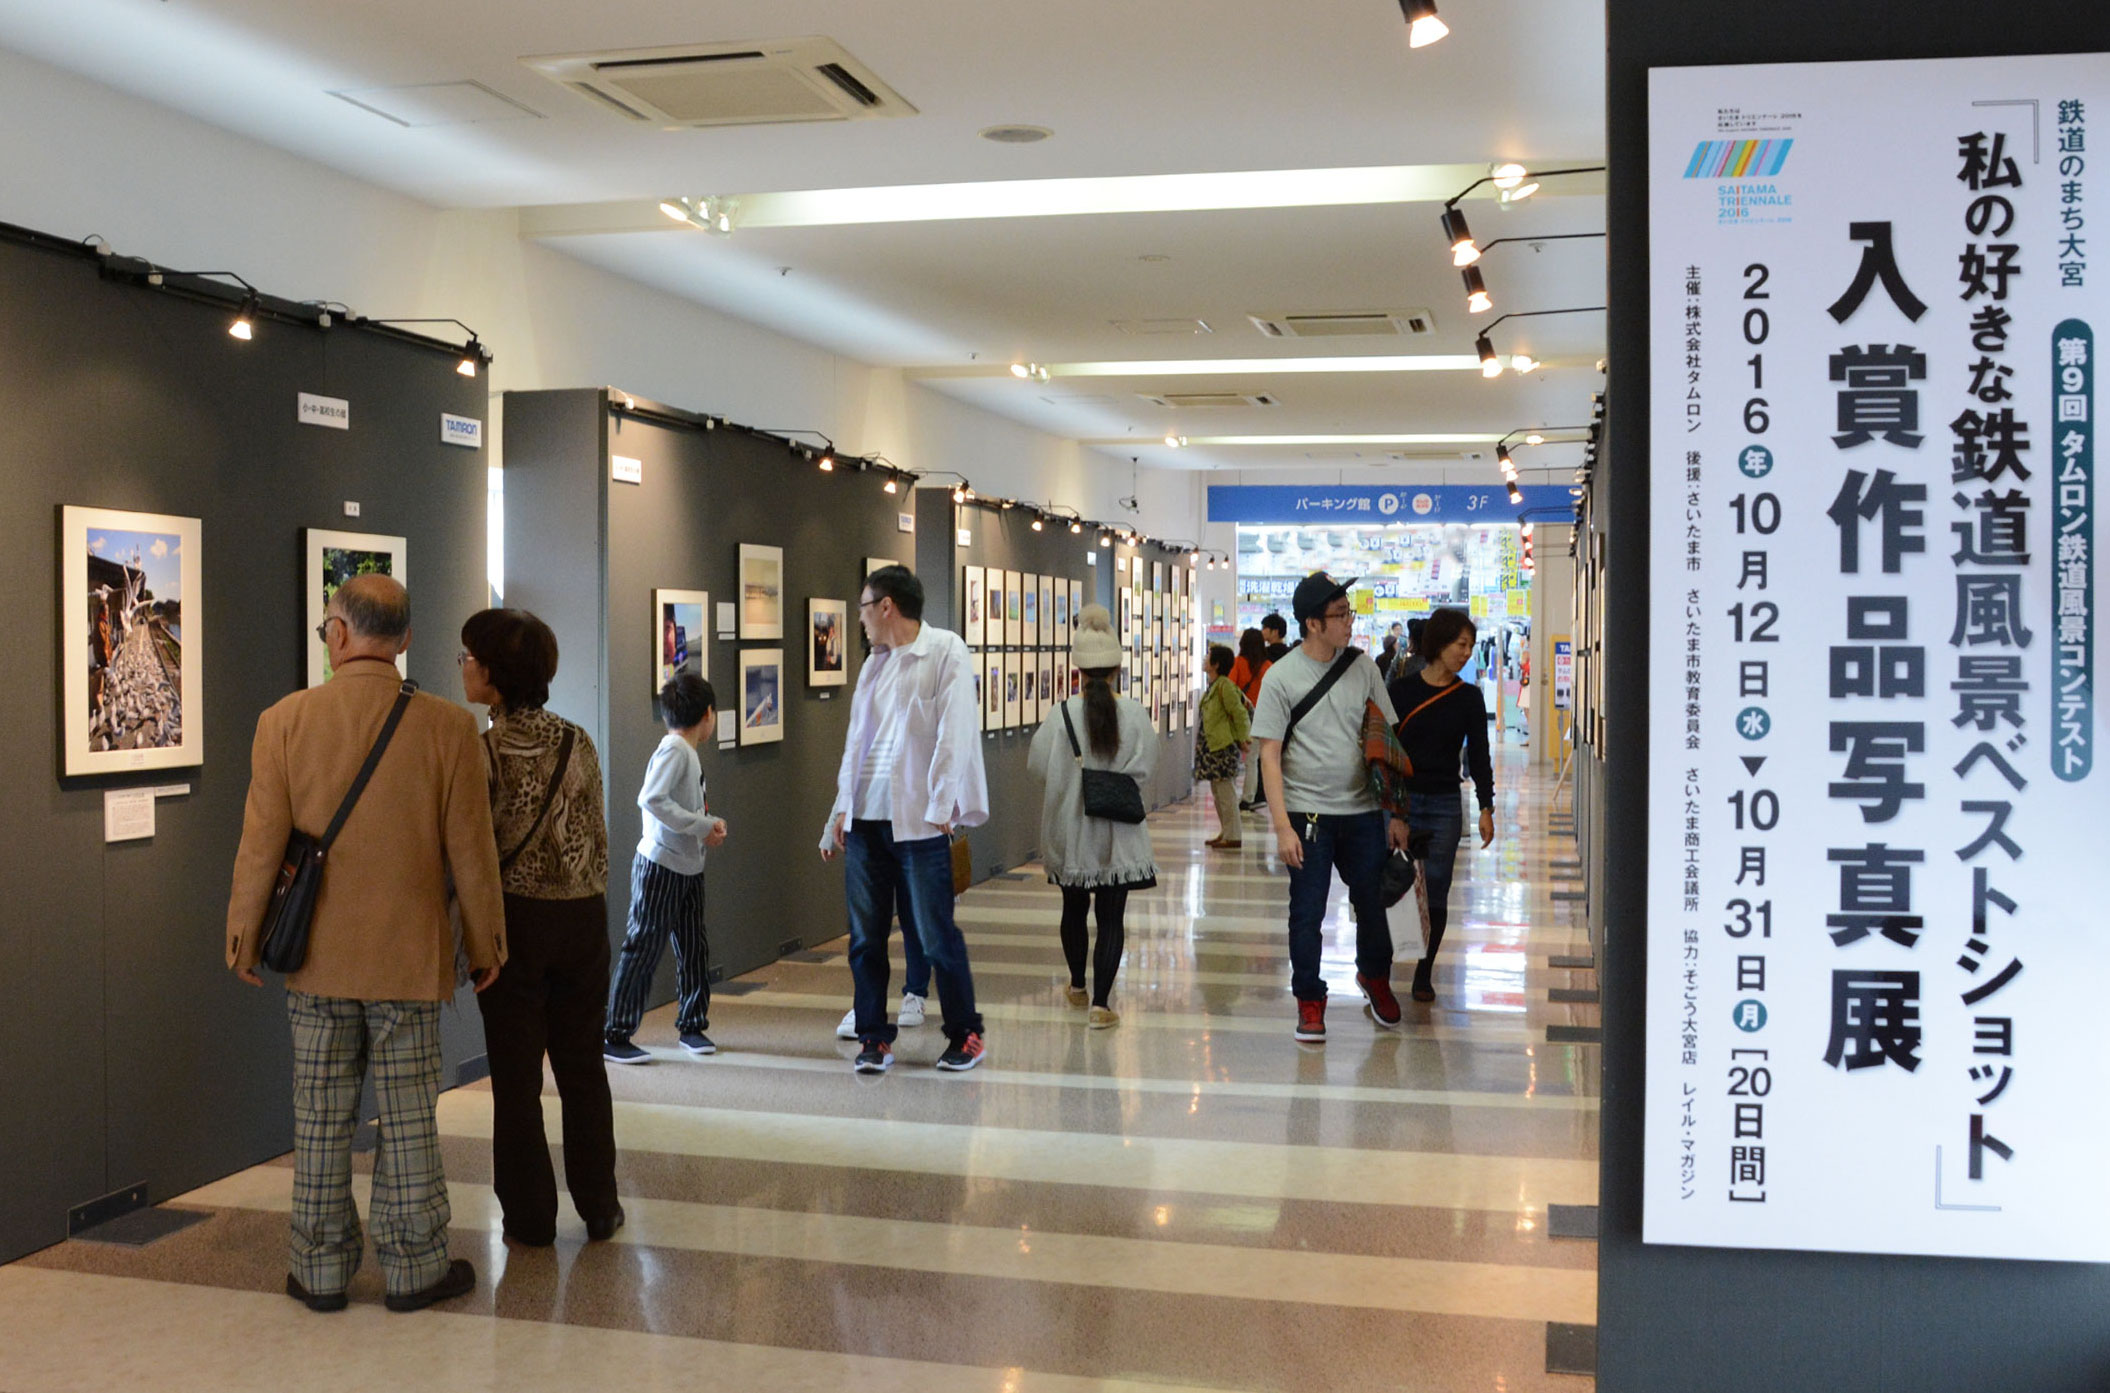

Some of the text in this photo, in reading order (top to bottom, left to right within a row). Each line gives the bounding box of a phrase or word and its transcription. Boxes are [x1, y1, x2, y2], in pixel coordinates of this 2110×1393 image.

[1718, 184, 1777, 195] SAITAMA
[2057, 99, 2086, 287] 鉄道のまち大宮
[1718, 194, 1792, 206] TRIENNALE
[1718, 207, 1749, 218] 2016
[446, 418, 478, 435] TAMRON
[1296, 498, 1371, 511] パーキング館
[1467, 495, 1489, 511] 3F
[1822, 220, 1929, 1073] 入賞作品写真展
